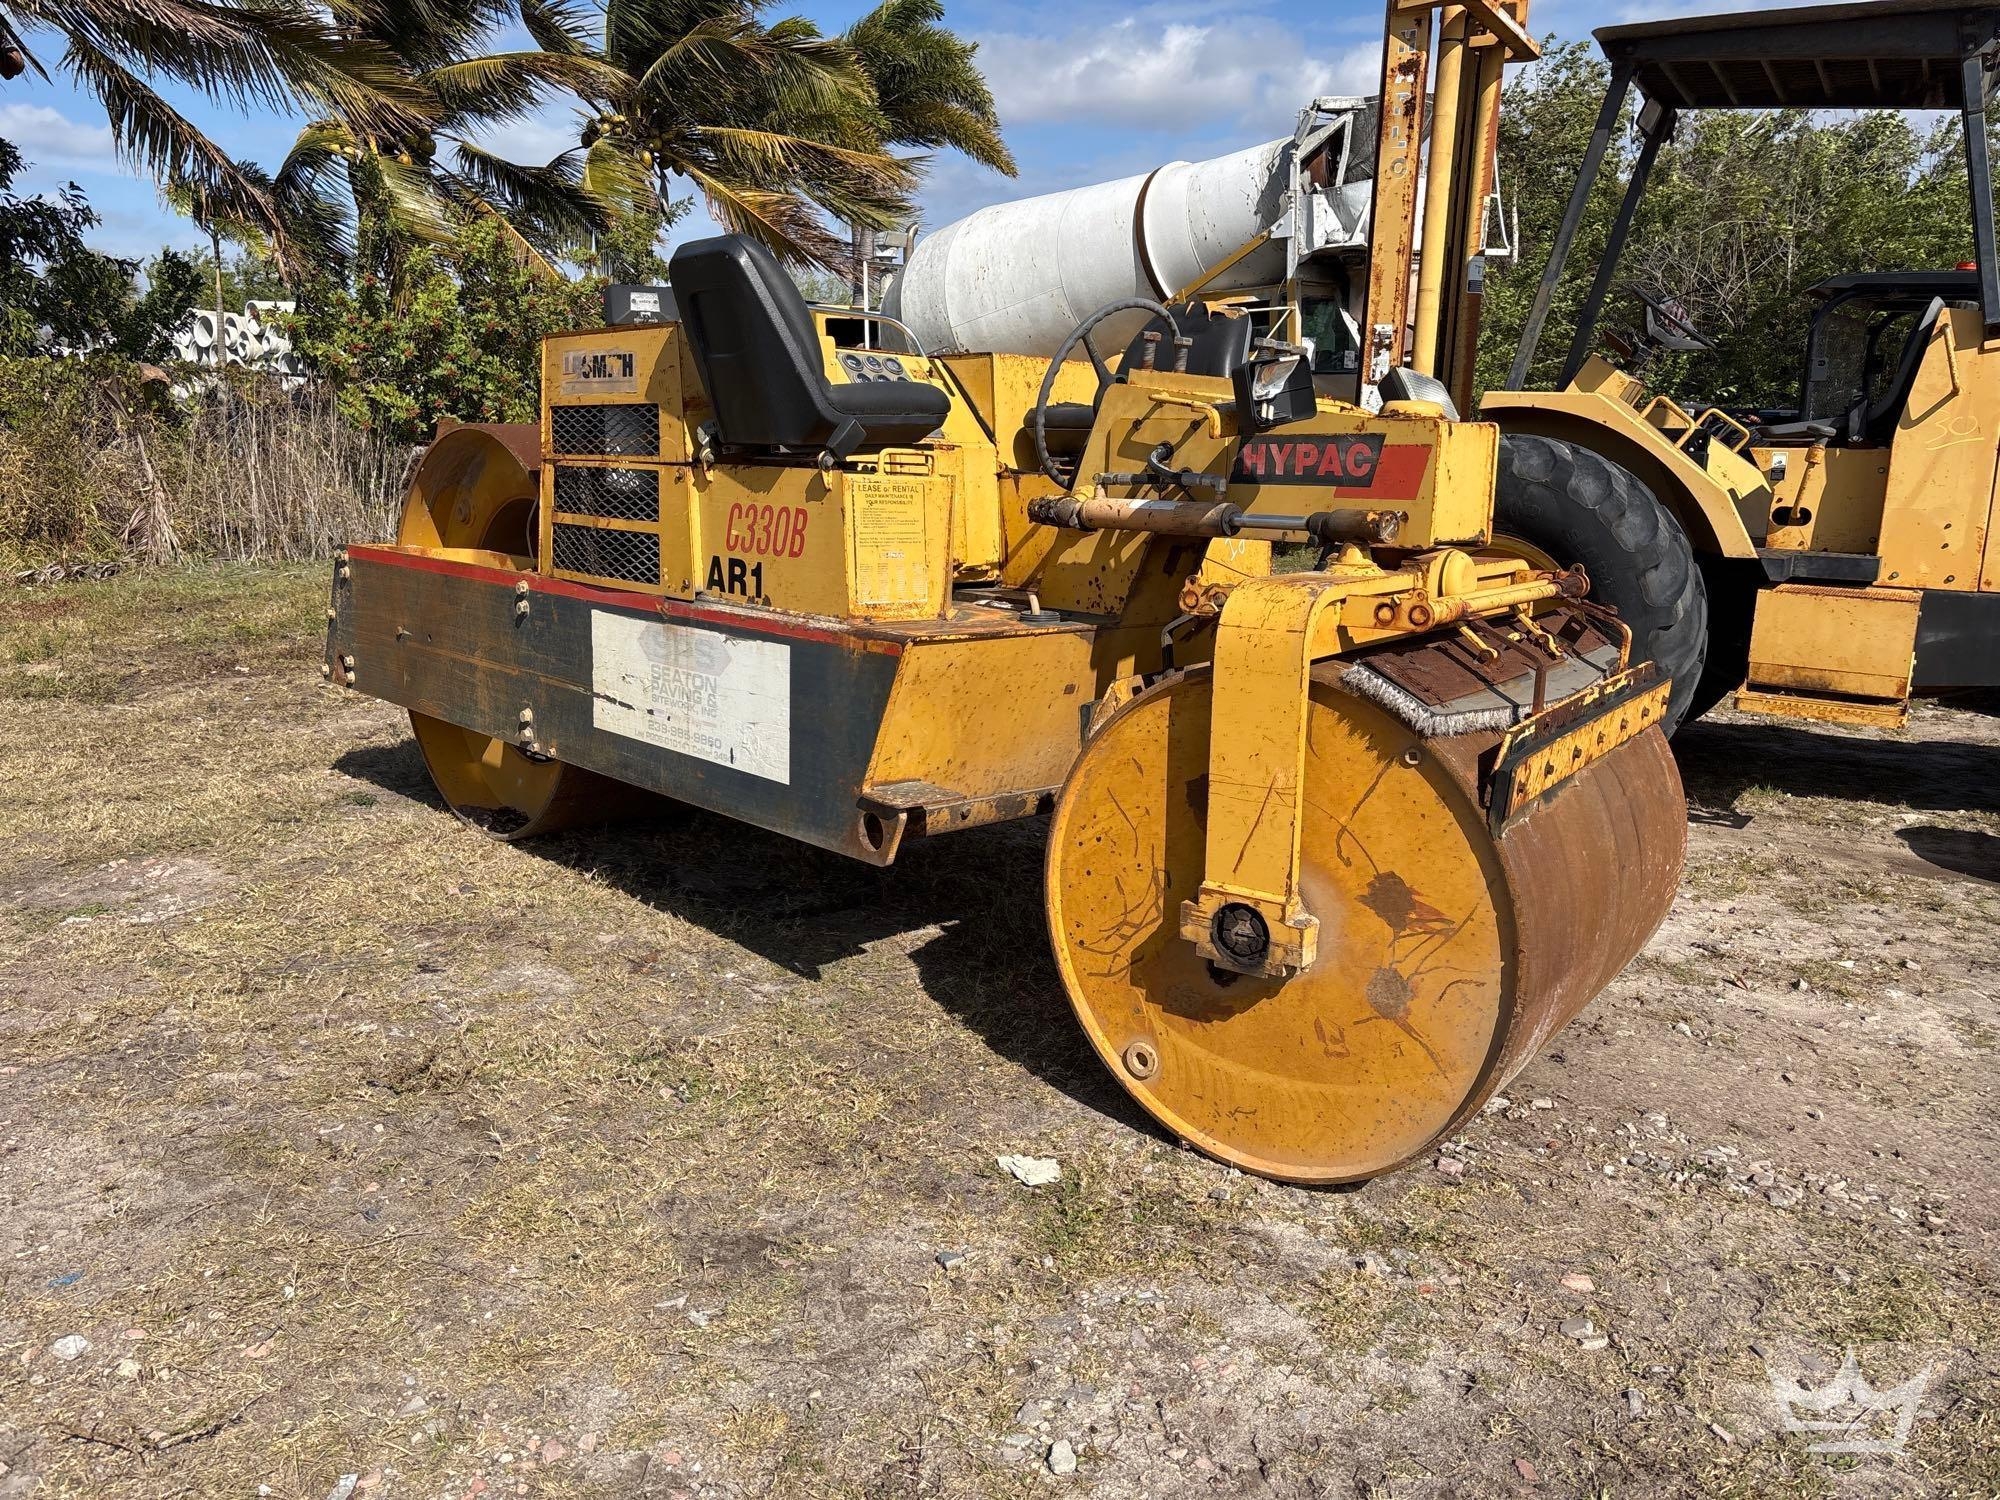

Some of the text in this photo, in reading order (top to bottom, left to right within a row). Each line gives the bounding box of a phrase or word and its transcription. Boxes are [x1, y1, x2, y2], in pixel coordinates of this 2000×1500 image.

[1242, 442, 1373, 477] HYPAC
[858, 484, 881, 492] LEASE
[892, 485, 919, 493] RENTAL
[726, 502, 808, 558] C330B
[706, 555, 762, 598] AR1
[651, 663, 717, 694] SEATON
[651, 680, 717, 709] PAVING &
